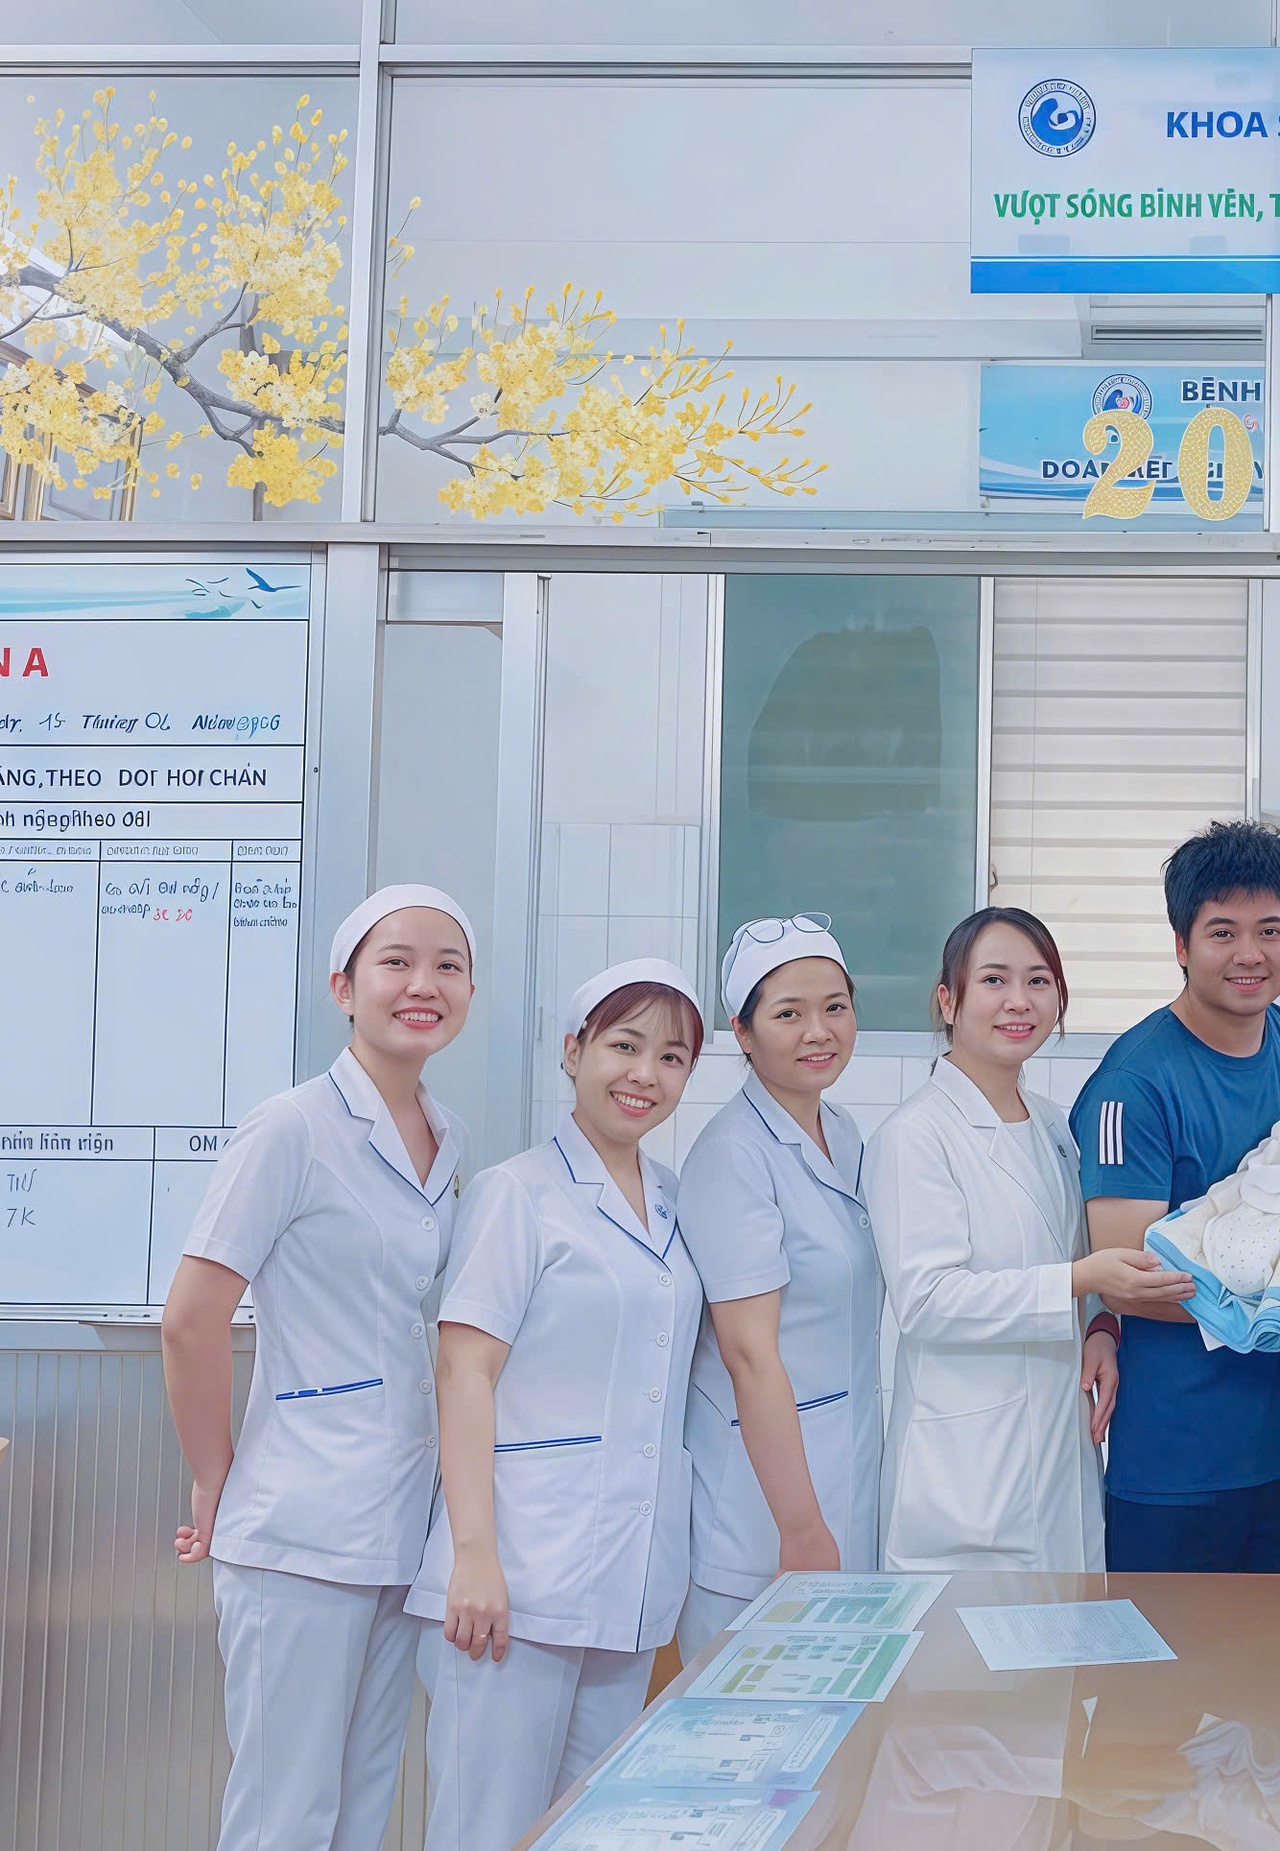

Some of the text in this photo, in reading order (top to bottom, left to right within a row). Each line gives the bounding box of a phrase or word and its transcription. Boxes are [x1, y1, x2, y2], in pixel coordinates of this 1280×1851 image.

[1167, 111, 1268, 138] KHOA
[1066, 188, 1133, 218] SÓNG
[22, 647, 49, 677] A
[46, 769, 101, 787] THEO
